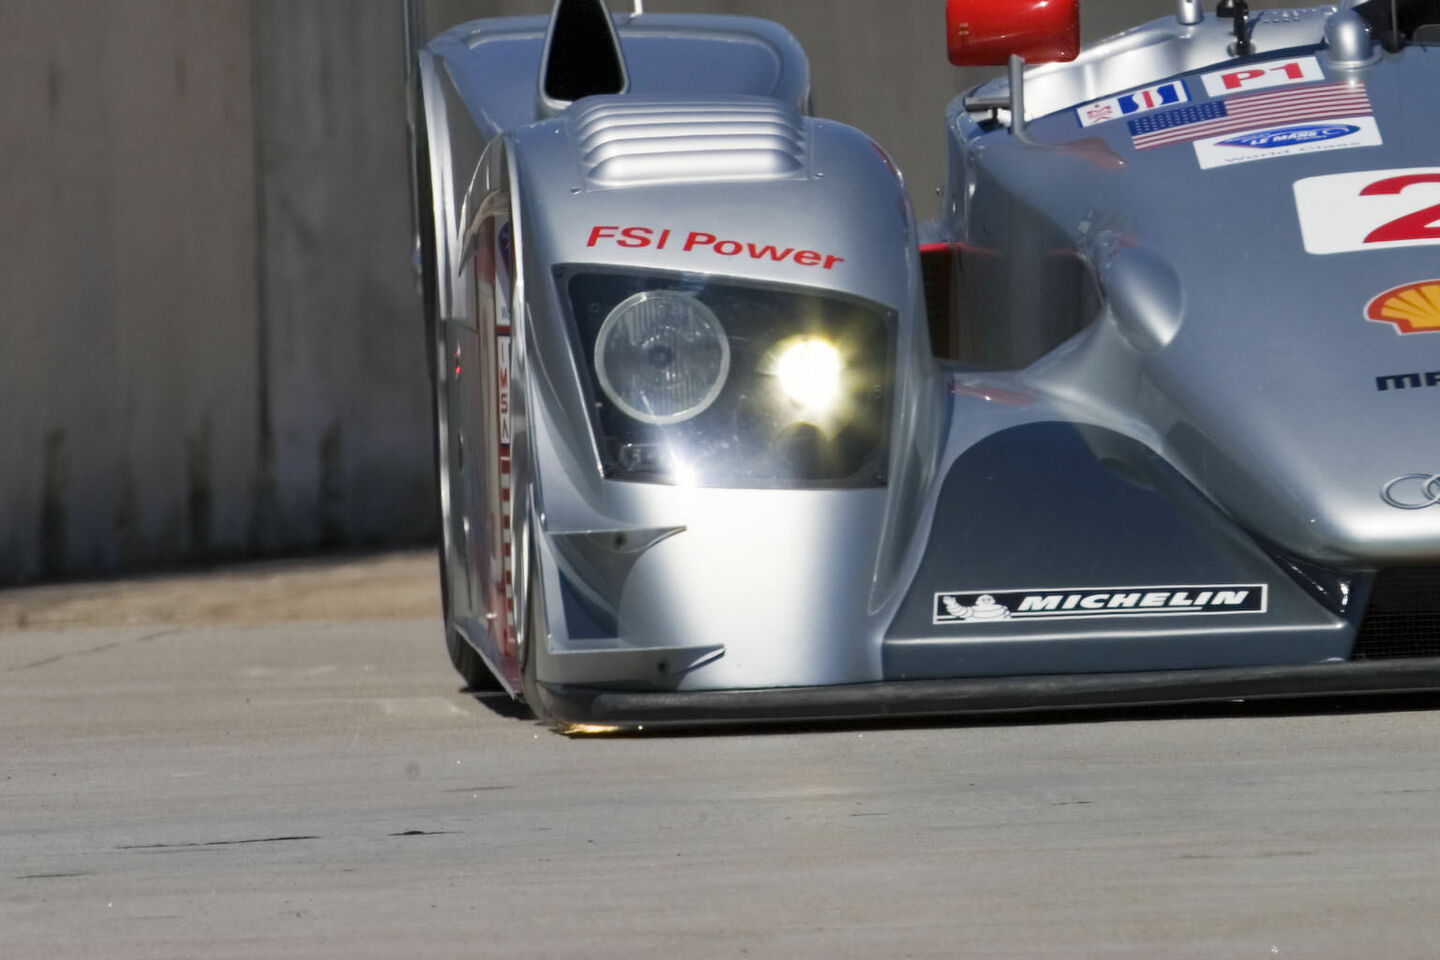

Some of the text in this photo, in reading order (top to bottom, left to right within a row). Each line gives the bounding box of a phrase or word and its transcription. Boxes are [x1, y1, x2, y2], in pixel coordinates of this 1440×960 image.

[1221, 62, 1303, 90] P1
[586, 226, 845, 270] FSI Power
[1017, 590, 1249, 612] MICHELIN
